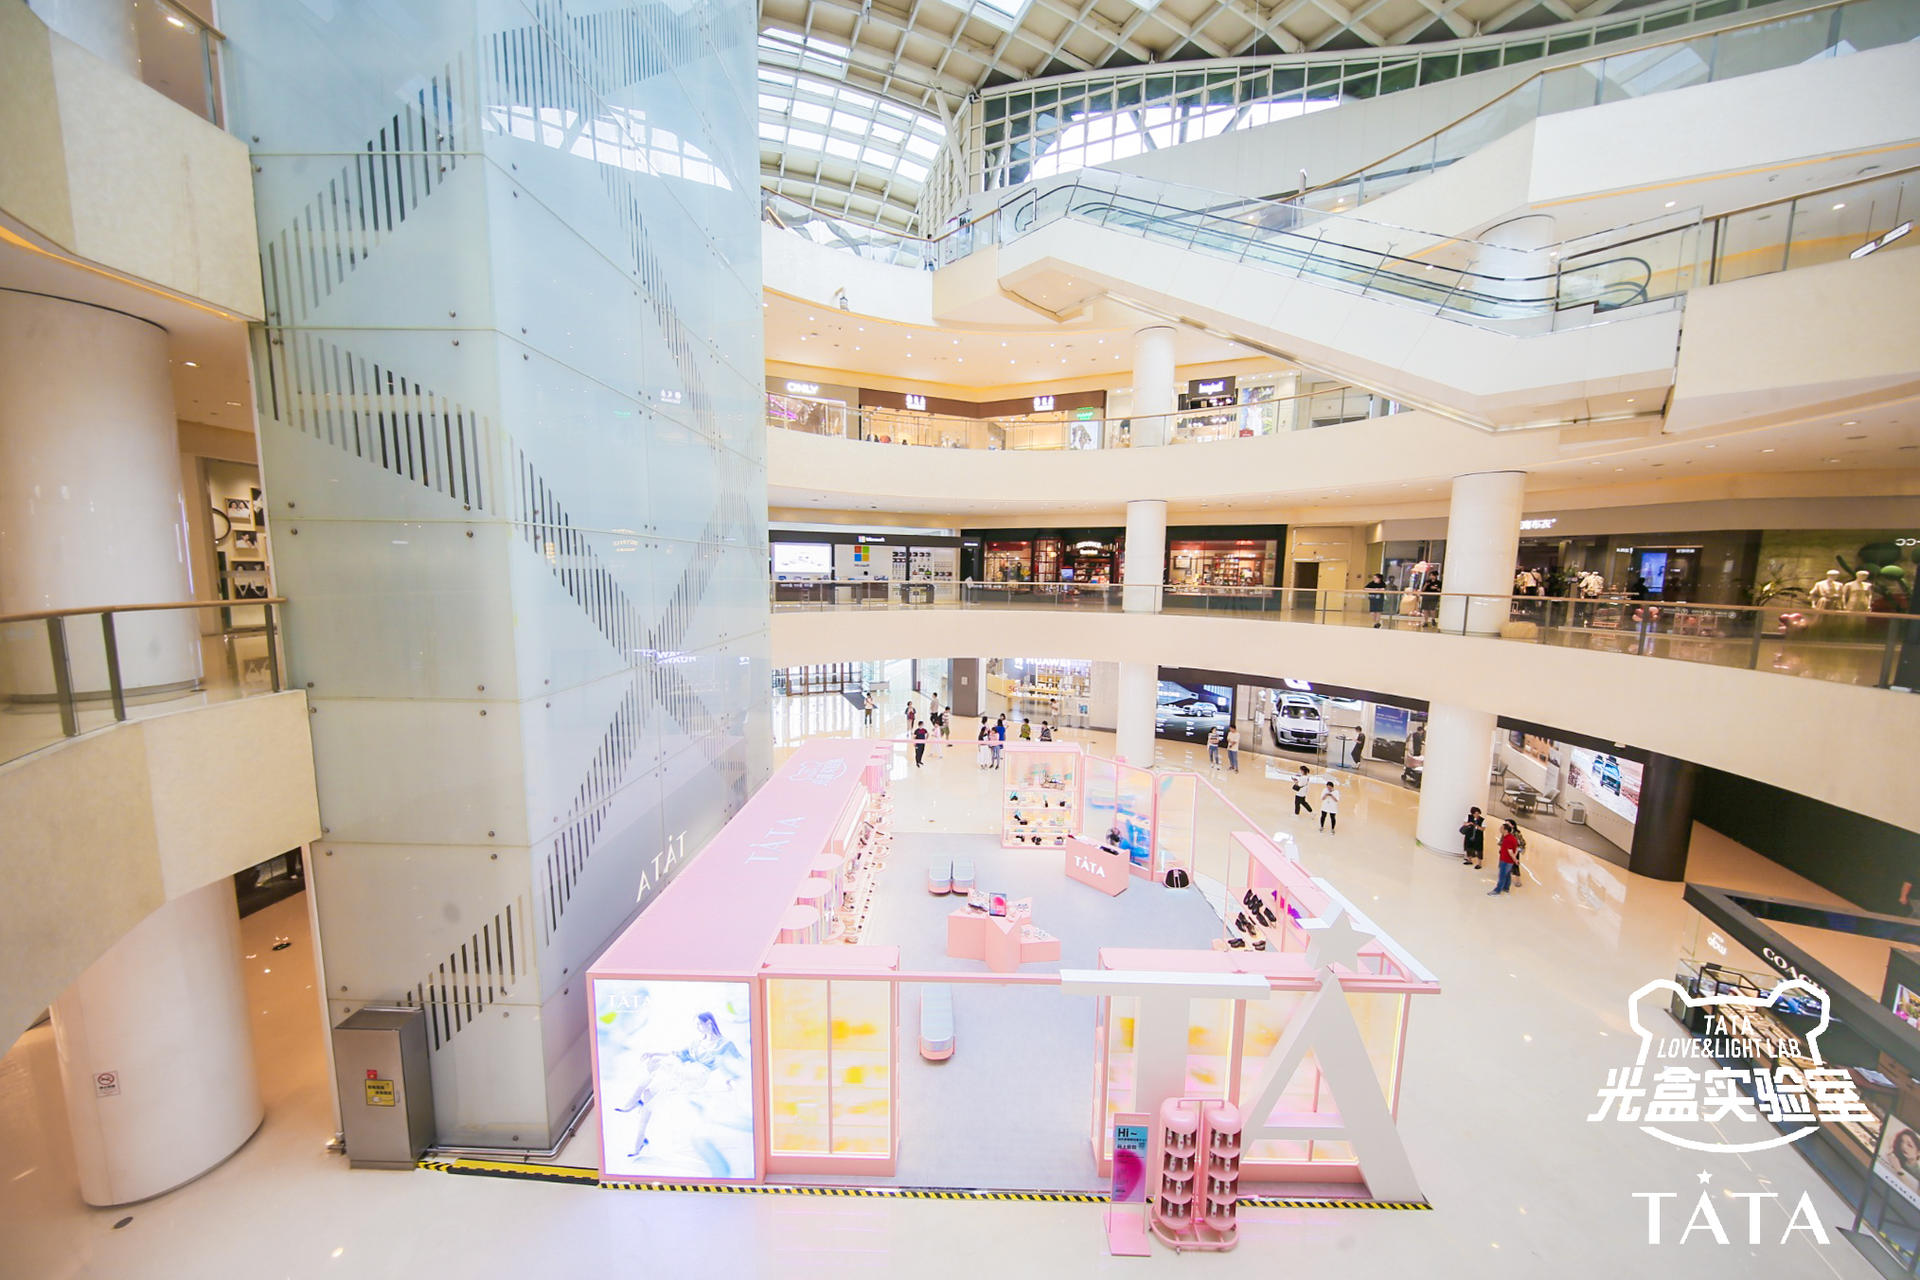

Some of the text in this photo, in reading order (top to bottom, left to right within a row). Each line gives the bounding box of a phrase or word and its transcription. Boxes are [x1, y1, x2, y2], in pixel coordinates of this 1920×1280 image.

[1519, 519, 1552, 530] 南布衣
[1074, 855, 1106, 878] TATA
